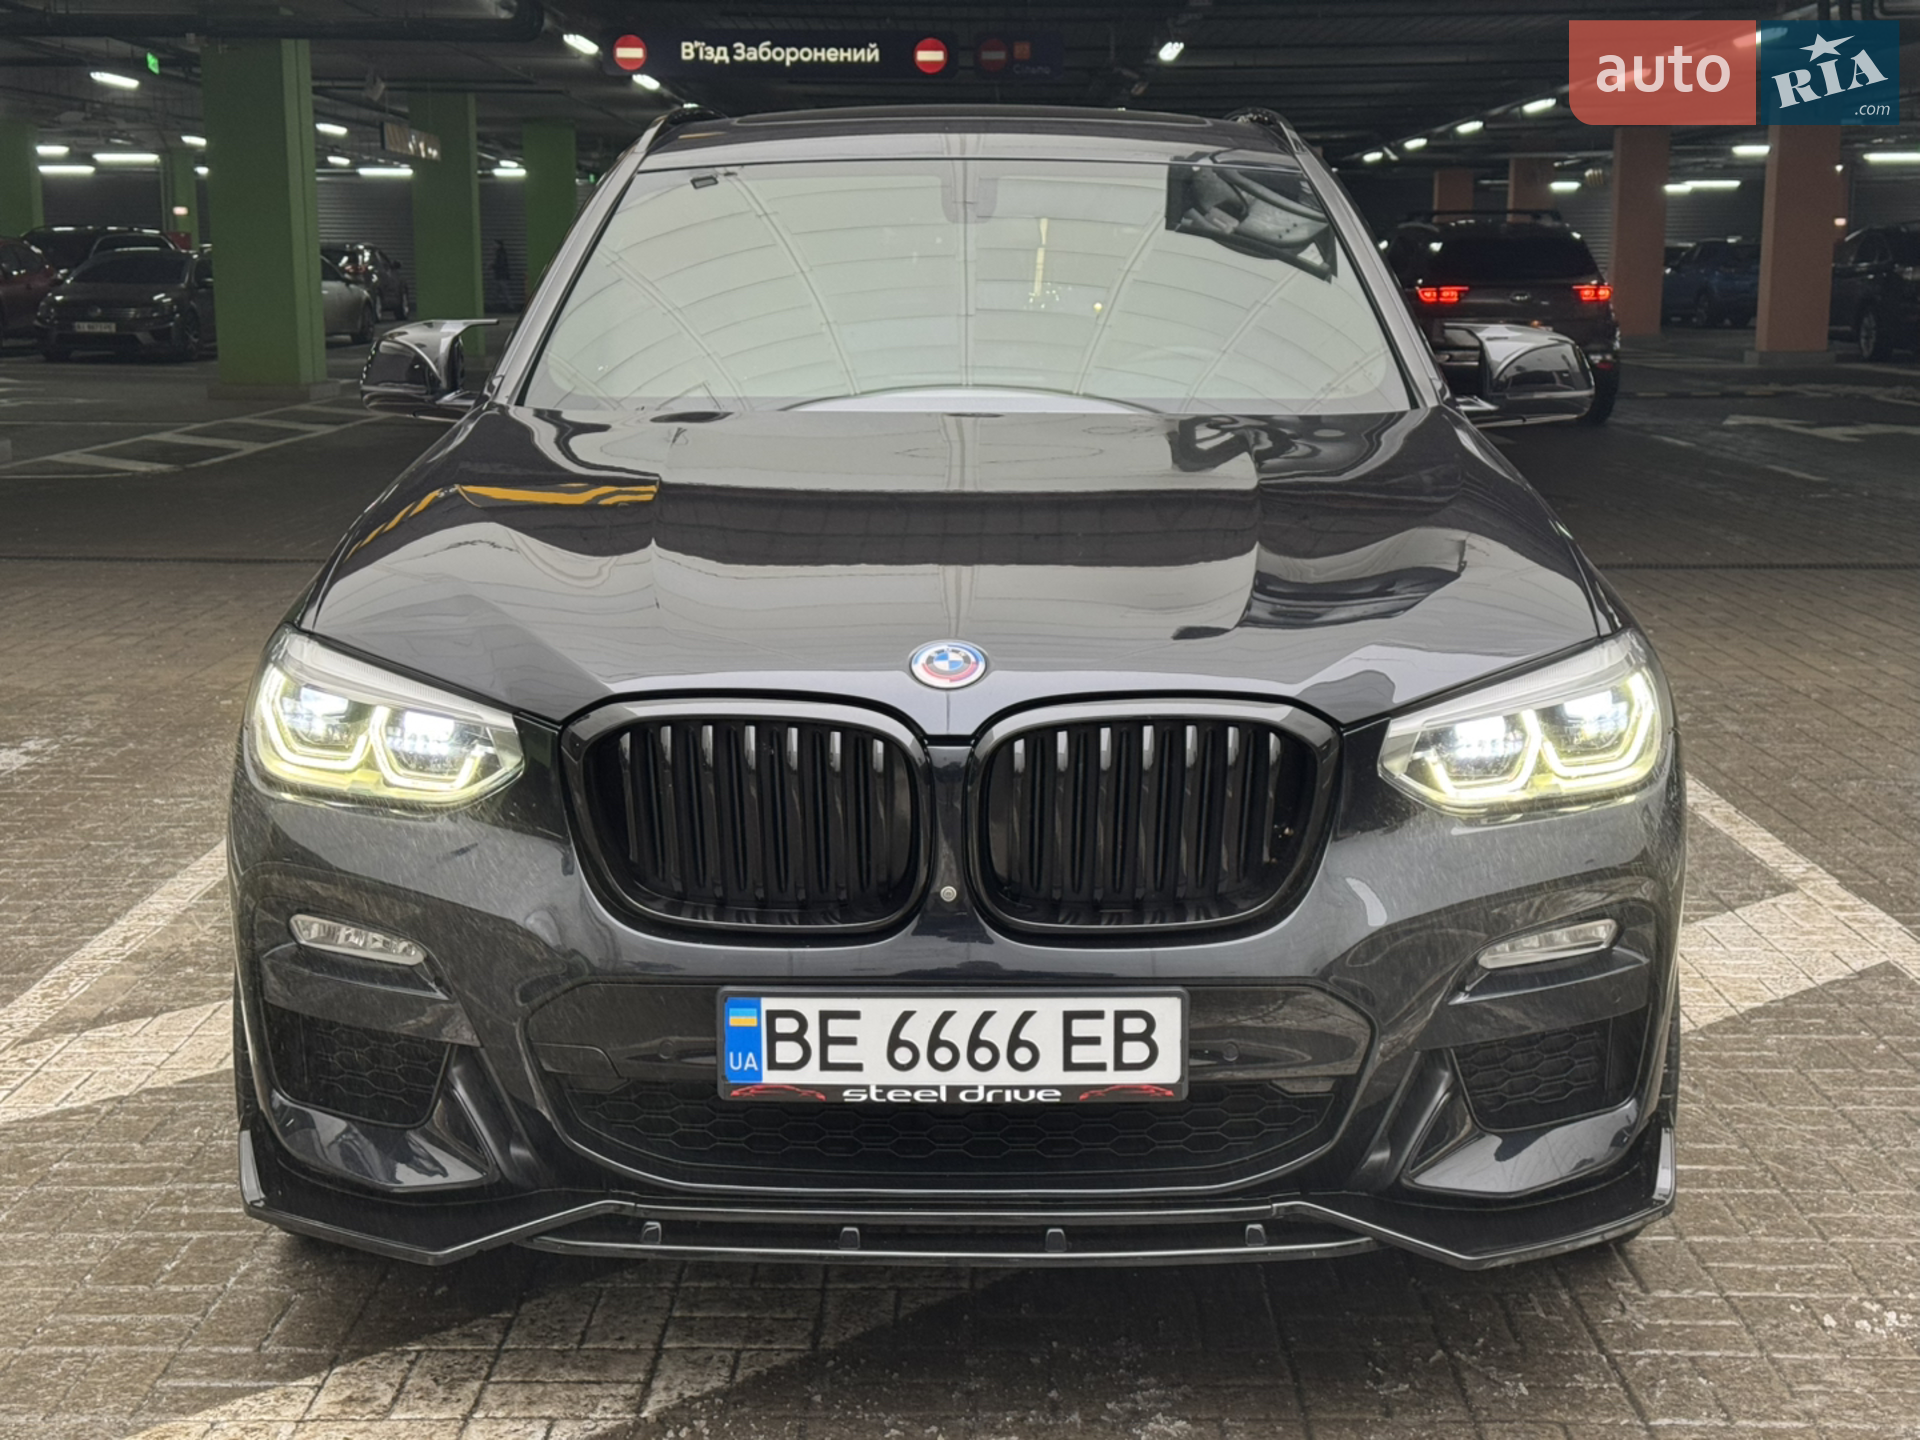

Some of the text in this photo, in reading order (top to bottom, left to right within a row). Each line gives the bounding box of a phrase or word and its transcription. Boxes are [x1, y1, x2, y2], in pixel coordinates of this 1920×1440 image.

[732, 41, 880, 67] Заборонений
[765, 1009, 1159, 1073] BE 6666 EB
[729, 1052, 759, 1072] UA
[842, 1085, 1062, 1103] steel drive
